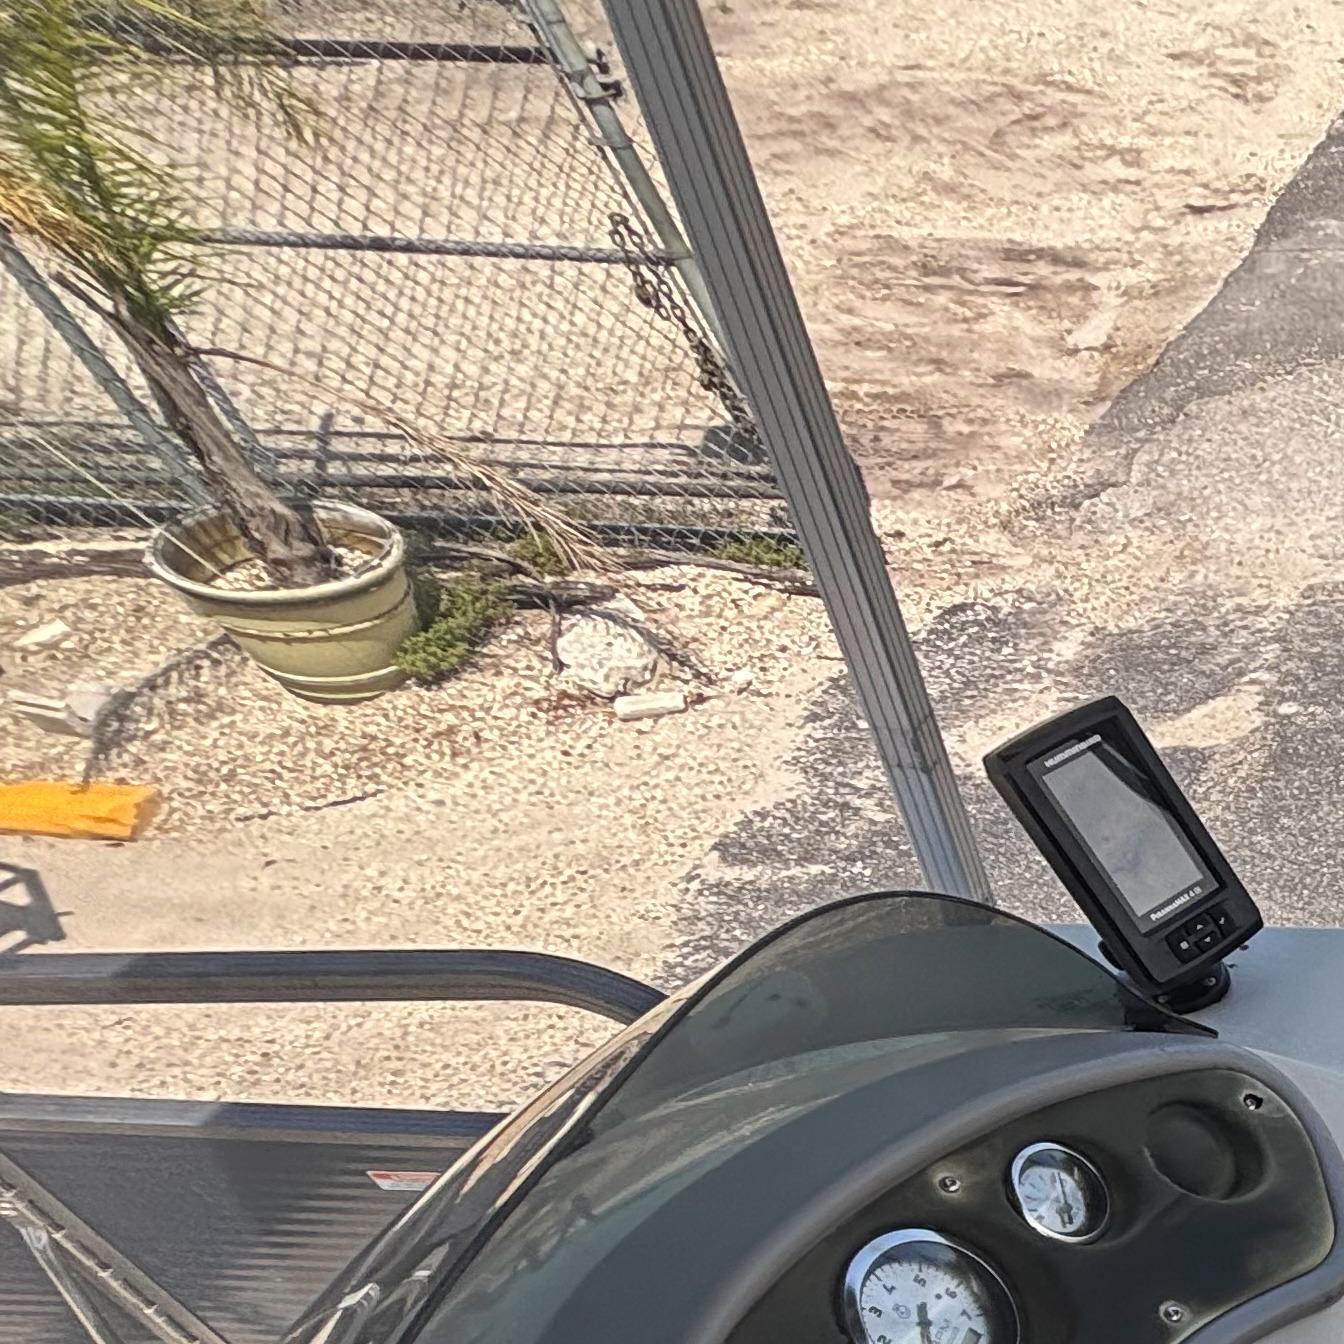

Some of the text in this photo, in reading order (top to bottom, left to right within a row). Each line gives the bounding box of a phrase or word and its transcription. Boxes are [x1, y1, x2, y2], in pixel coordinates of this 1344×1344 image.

[913, 1274, 927, 1288] 5
[883, 1283, 896, 1295] 4
[945, 1287, 958, 1299] 6
[868, 1304, 883, 1319] 3
[960, 1308, 972, 1322] 7
